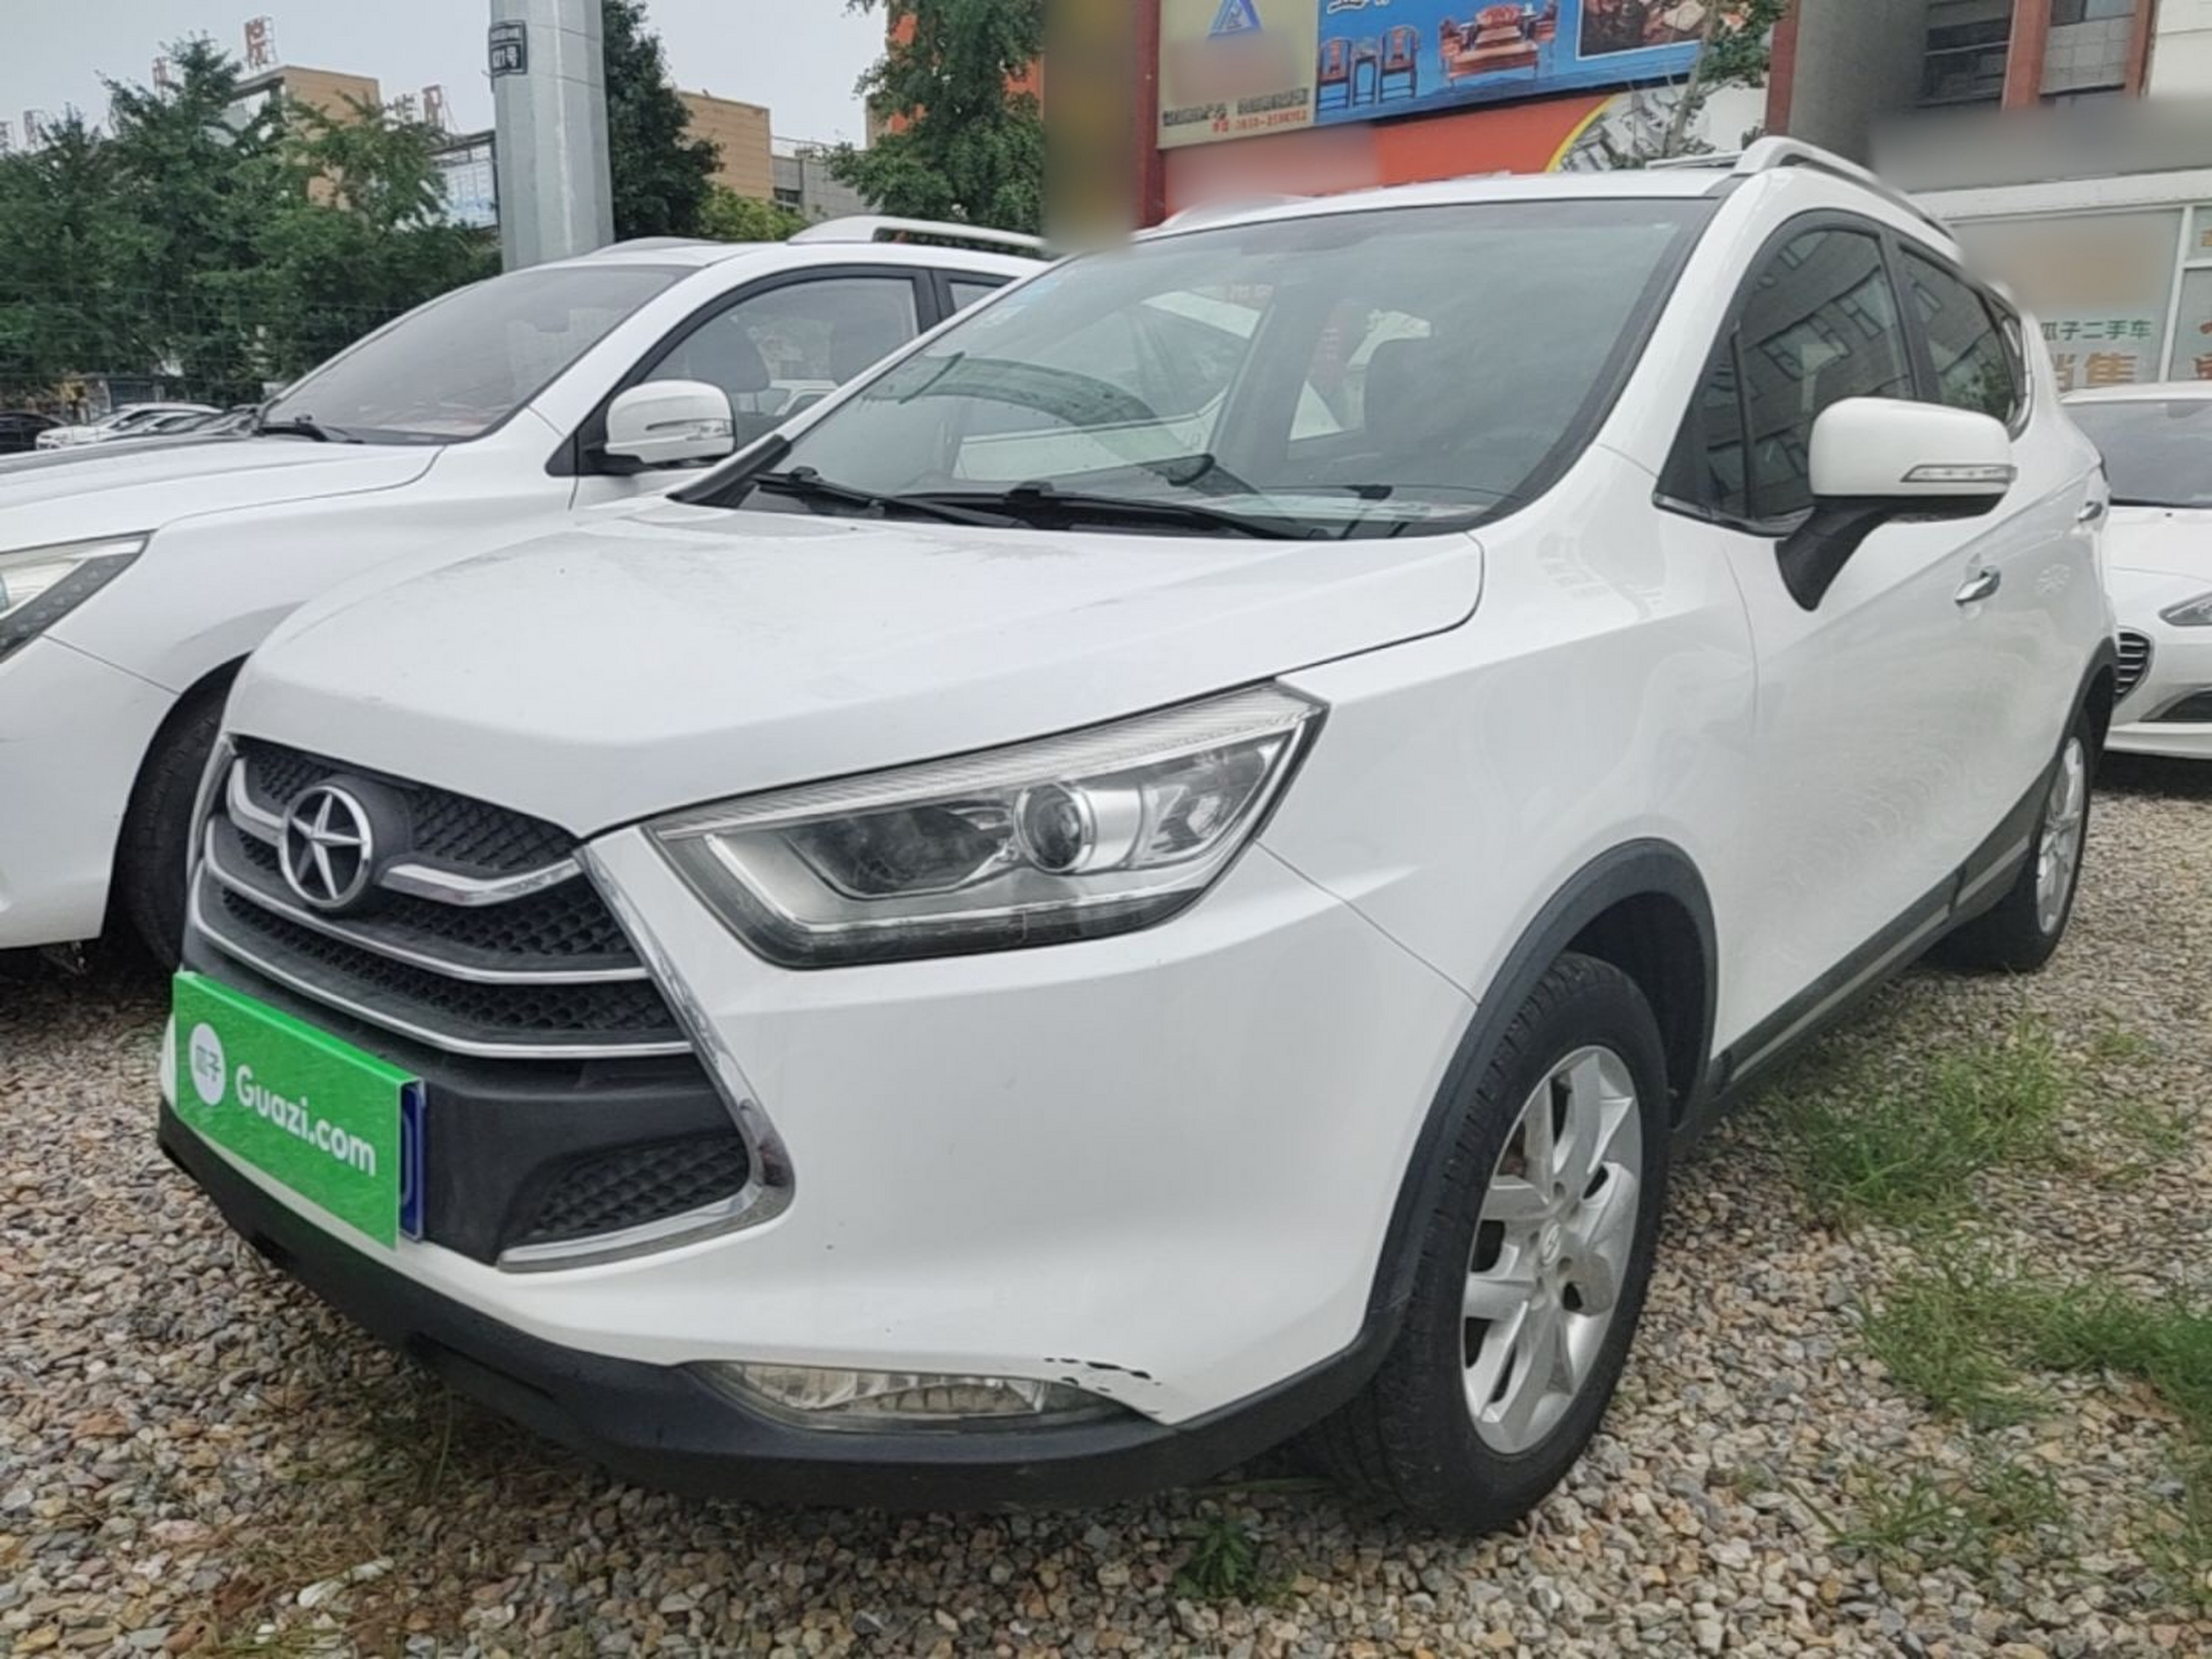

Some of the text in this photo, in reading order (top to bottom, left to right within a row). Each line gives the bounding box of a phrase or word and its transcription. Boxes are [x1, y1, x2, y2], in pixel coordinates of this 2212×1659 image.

[2040, 320, 2152, 341] 瓜子二手车
[235, 1064, 376, 1177] Guazi.com
